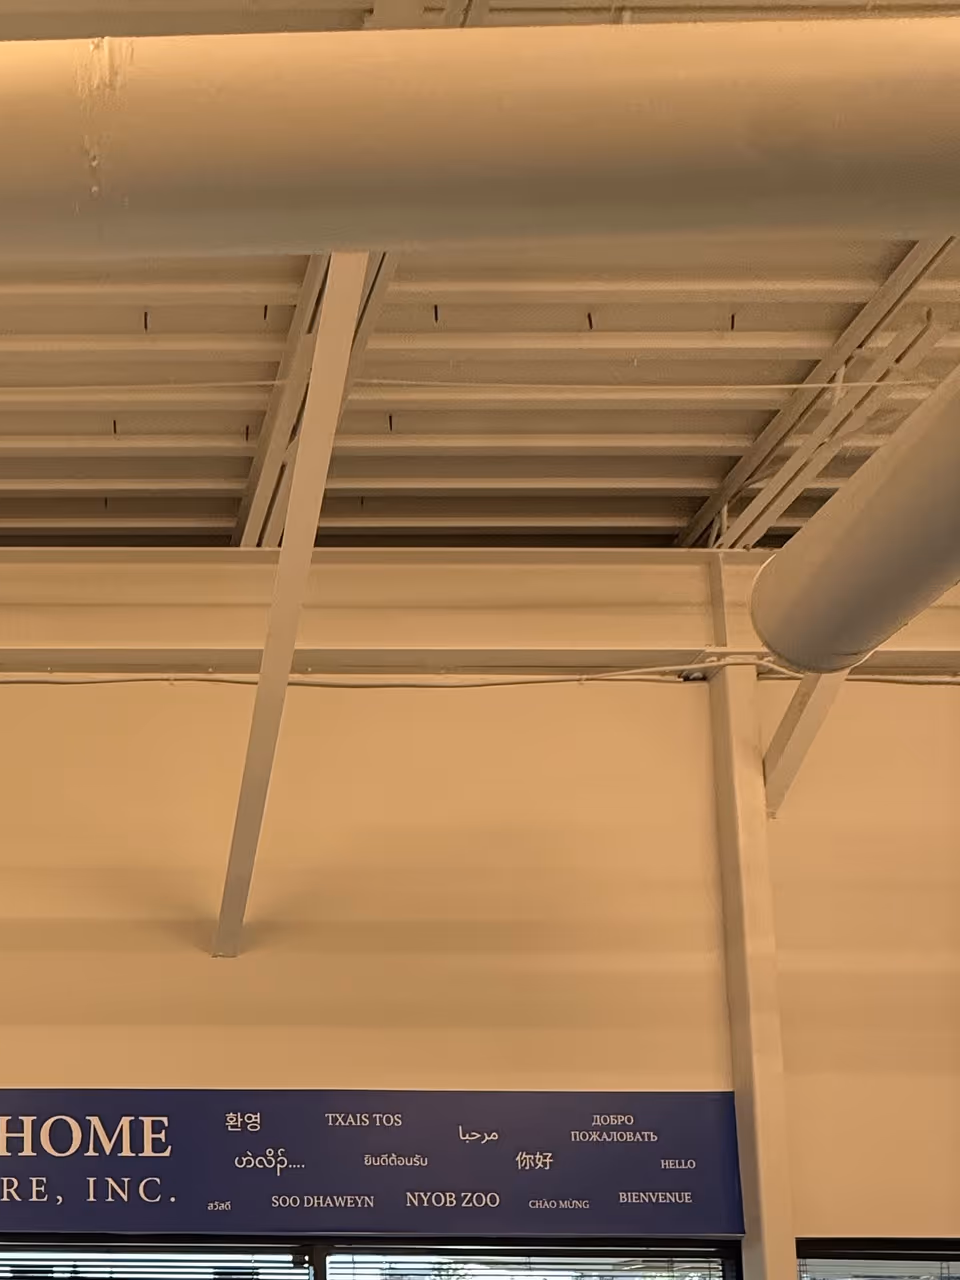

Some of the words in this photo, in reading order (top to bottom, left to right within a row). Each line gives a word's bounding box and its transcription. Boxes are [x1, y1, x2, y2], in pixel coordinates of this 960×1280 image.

[226, 1113, 260, 1131] 환영
[325, 1114, 369, 1125] TXAIS
[373, 1114, 401, 1126] TOS
[592, 1115, 633, 1125] ДОБРО
[459, 1126, 498, 1143] مرحبا
[571, 1131, 657, 1141] ПОЖАЛОВАТЬ
[365, 1154, 427, 1166] ยินดีต้อนรับ
[516, 1152, 553, 1169] 你好
[661, 1160, 695, 1168] HELLO
[87, 1178, 175, 1202] INC.
[272, 1196, 300, 1207] SOO
[304, 1196, 373, 1207] DHAWEYN
[407, 1192, 456, 1206] NYOB
[461, 1193, 499, 1207] ZOO
[529, 1199, 557, 1208] CHÀO
[619, 1193, 692, 1202] BIENVENUE
